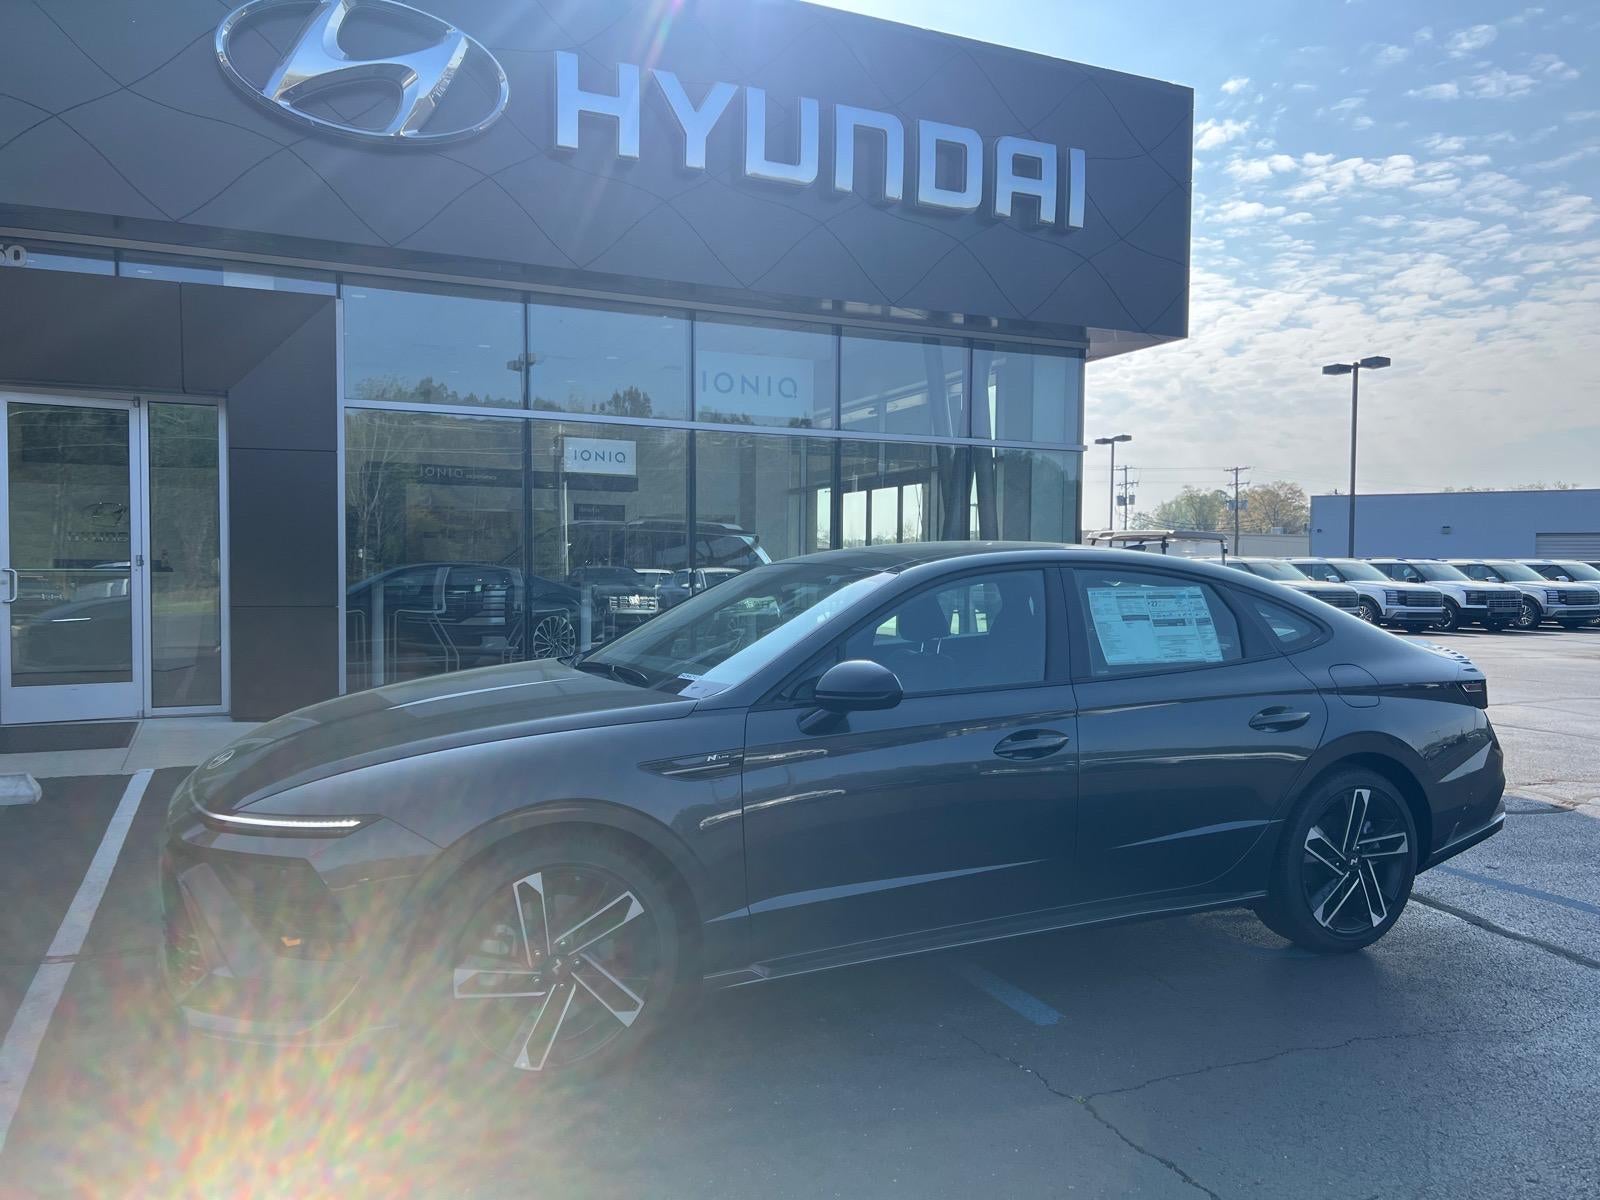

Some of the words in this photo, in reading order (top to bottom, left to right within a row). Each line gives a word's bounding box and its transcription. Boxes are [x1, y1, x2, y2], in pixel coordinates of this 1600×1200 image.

[554, 50, 1086, 229] HYUNDAI
[702, 370, 798, 400] IONIQ
[574, 449, 626, 464] IONIQ
